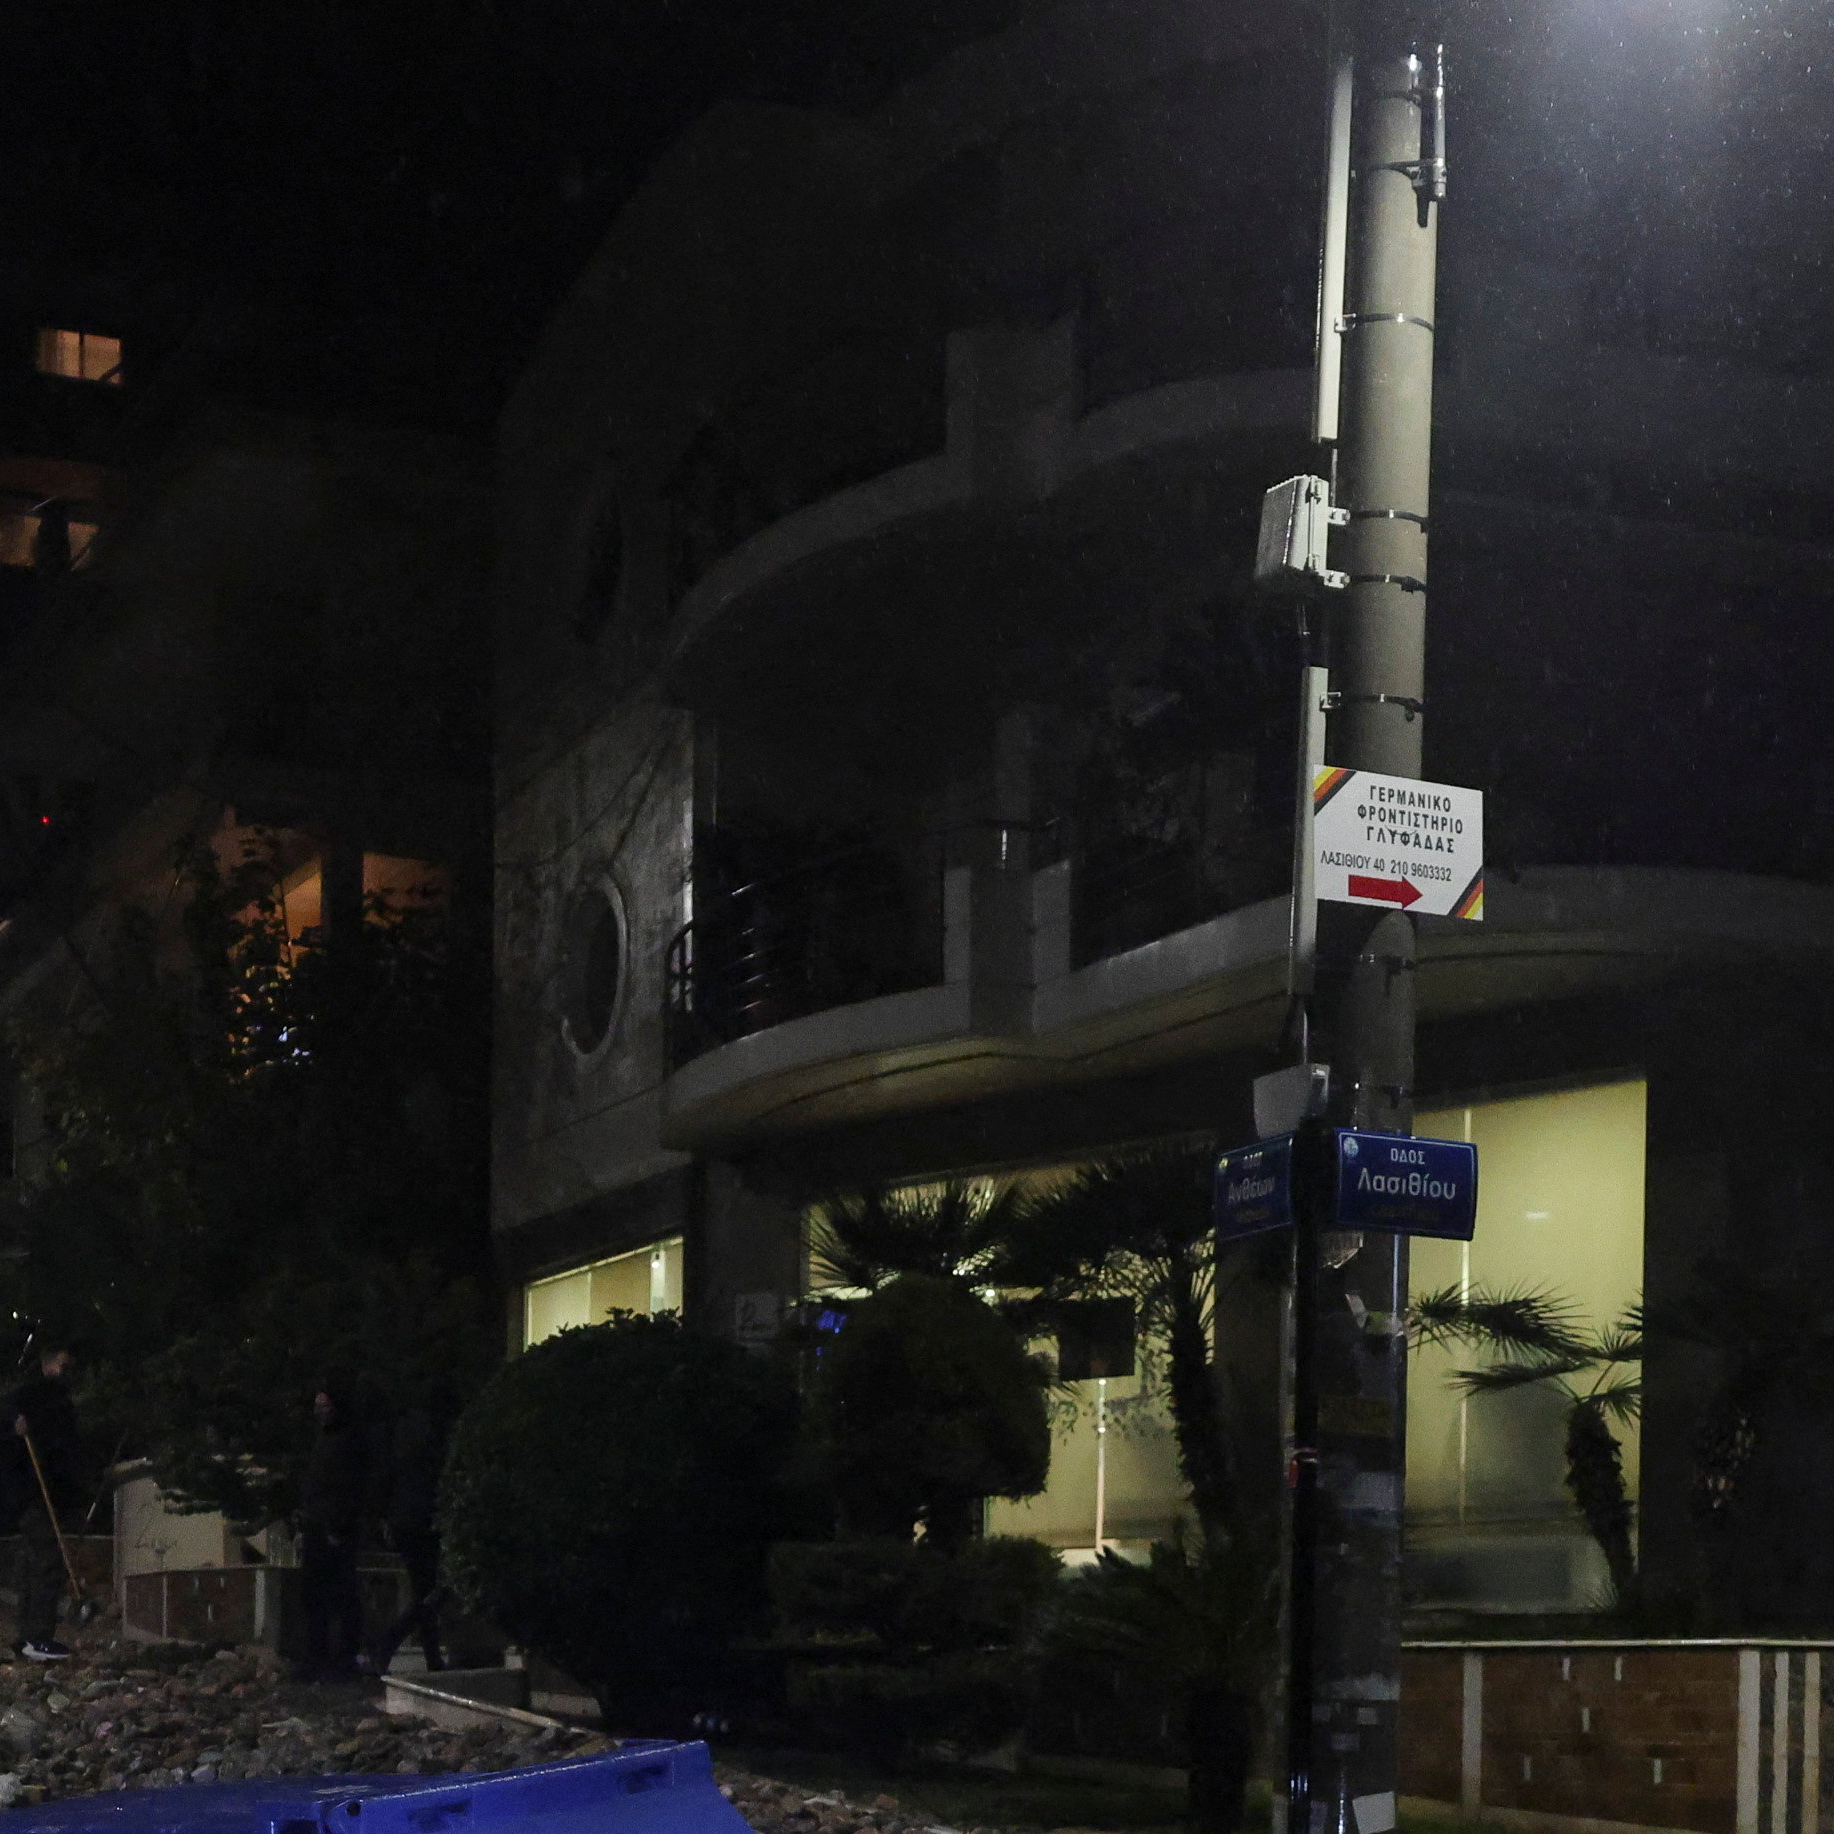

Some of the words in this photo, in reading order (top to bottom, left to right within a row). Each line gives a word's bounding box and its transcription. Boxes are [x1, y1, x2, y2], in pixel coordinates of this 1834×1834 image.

[1369, 784, 1452, 813] ΓΕΡΜΑΝΙΚΟ
[1357, 803, 1464, 834] ΦΡΟΝΤΙΣΤΗΡΙΟ
[1366, 826, 1456, 854] ΓΛΥΦΑΔΑΣ
[1320, 849, 1371, 870] ΛΑΣΙΘΙΟΥ
[1373, 858, 1385, 872] 40
[1390, 859, 1408, 875] 210
[1410, 862, 1452, 882] 9603332
[1390, 1147, 1426, 1165] ΟΔΟΣ
[1357, 1167, 1456, 1201] Λασιθίου
